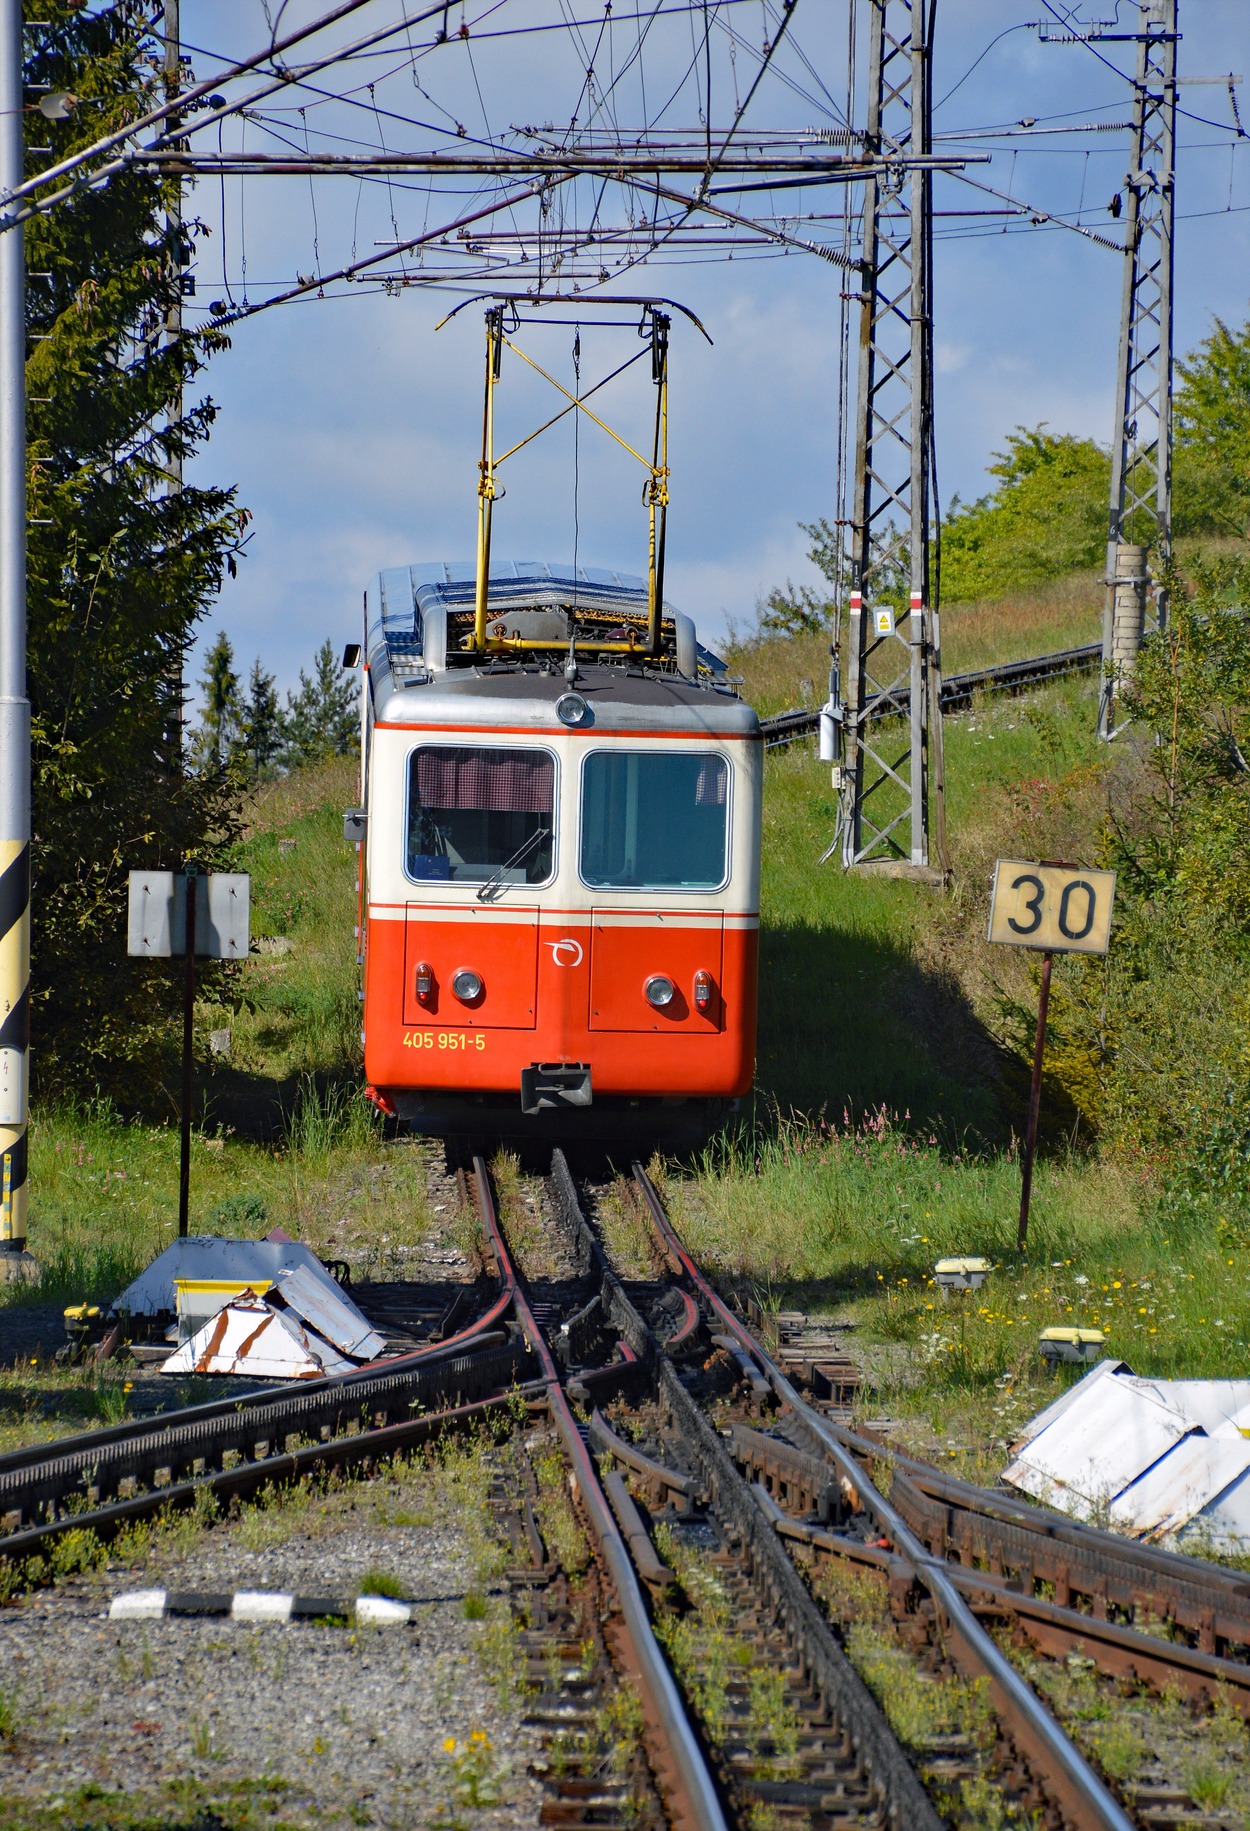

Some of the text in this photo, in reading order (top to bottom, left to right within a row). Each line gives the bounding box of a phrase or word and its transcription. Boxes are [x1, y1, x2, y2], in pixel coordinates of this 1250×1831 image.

[854, 564, 861, 588] 15
[1007, 874, 1097, 940] 30
[402, 1031, 486, 1051] 405 951-5
